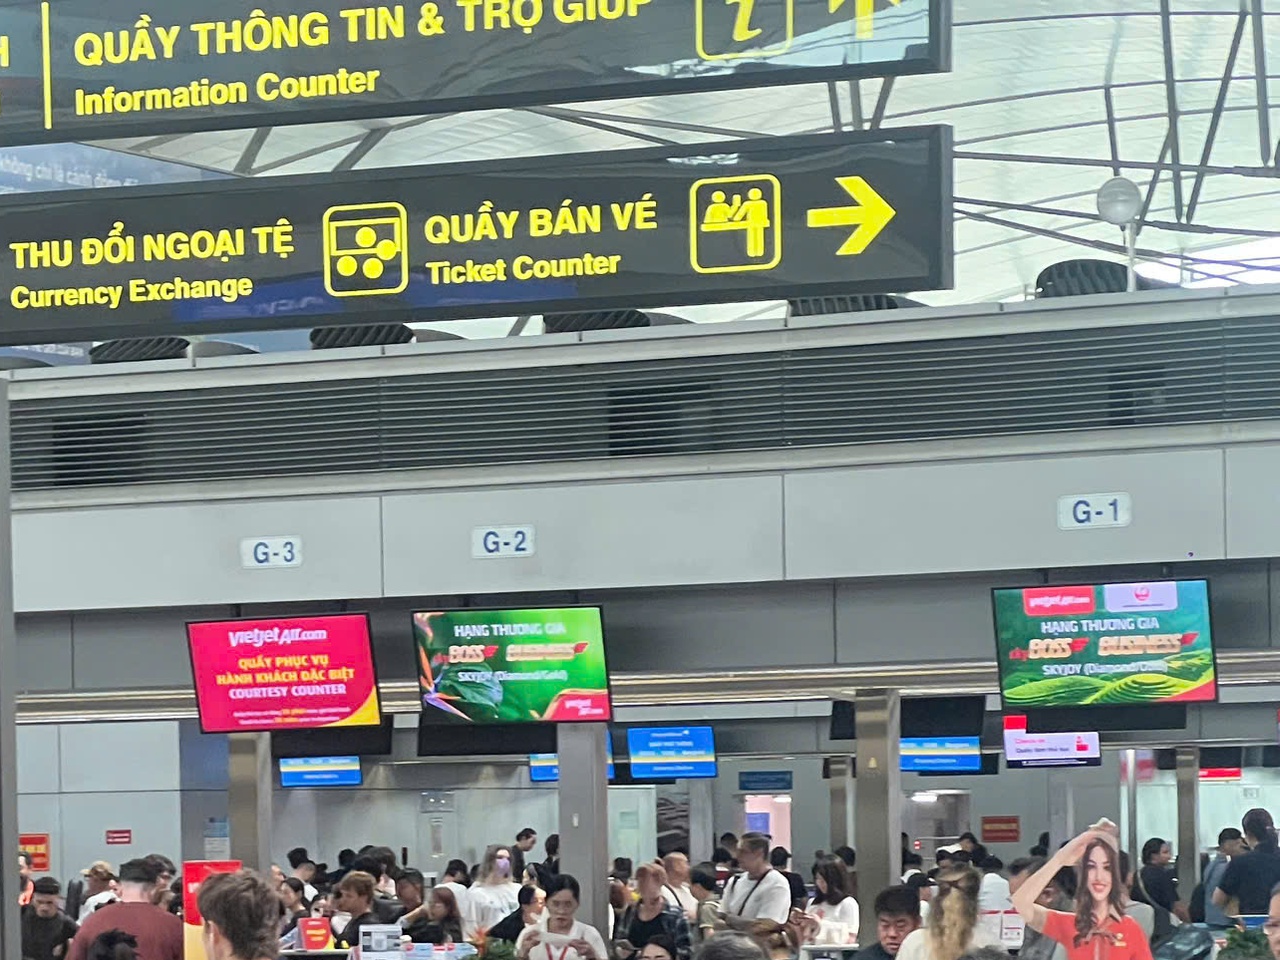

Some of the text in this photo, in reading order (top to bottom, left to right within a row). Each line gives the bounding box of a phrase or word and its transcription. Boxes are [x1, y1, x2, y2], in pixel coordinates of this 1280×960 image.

[75, 14, 181, 66] QUẦY
[190, 9, 329, 56] THÔNG
[340, 5, 405, 42] TIN
[418, 2, 445, 36] &
[75, 68, 381, 115] Information Counter
[424, 193, 658, 244] QUẦY BÁN VÉ
[9, 218, 295, 269] THU ĐỔI NGOẠI TỆ
[425, 252, 621, 285] Ticket Counter
[10, 277, 254, 309] Currency Exchange
[1072, 499, 1119, 524] G-1
[253, 541, 295, 564] G-3
[483, 530, 527, 554] G-2
[229, 684, 346, 699] COURTESY COUNTER
